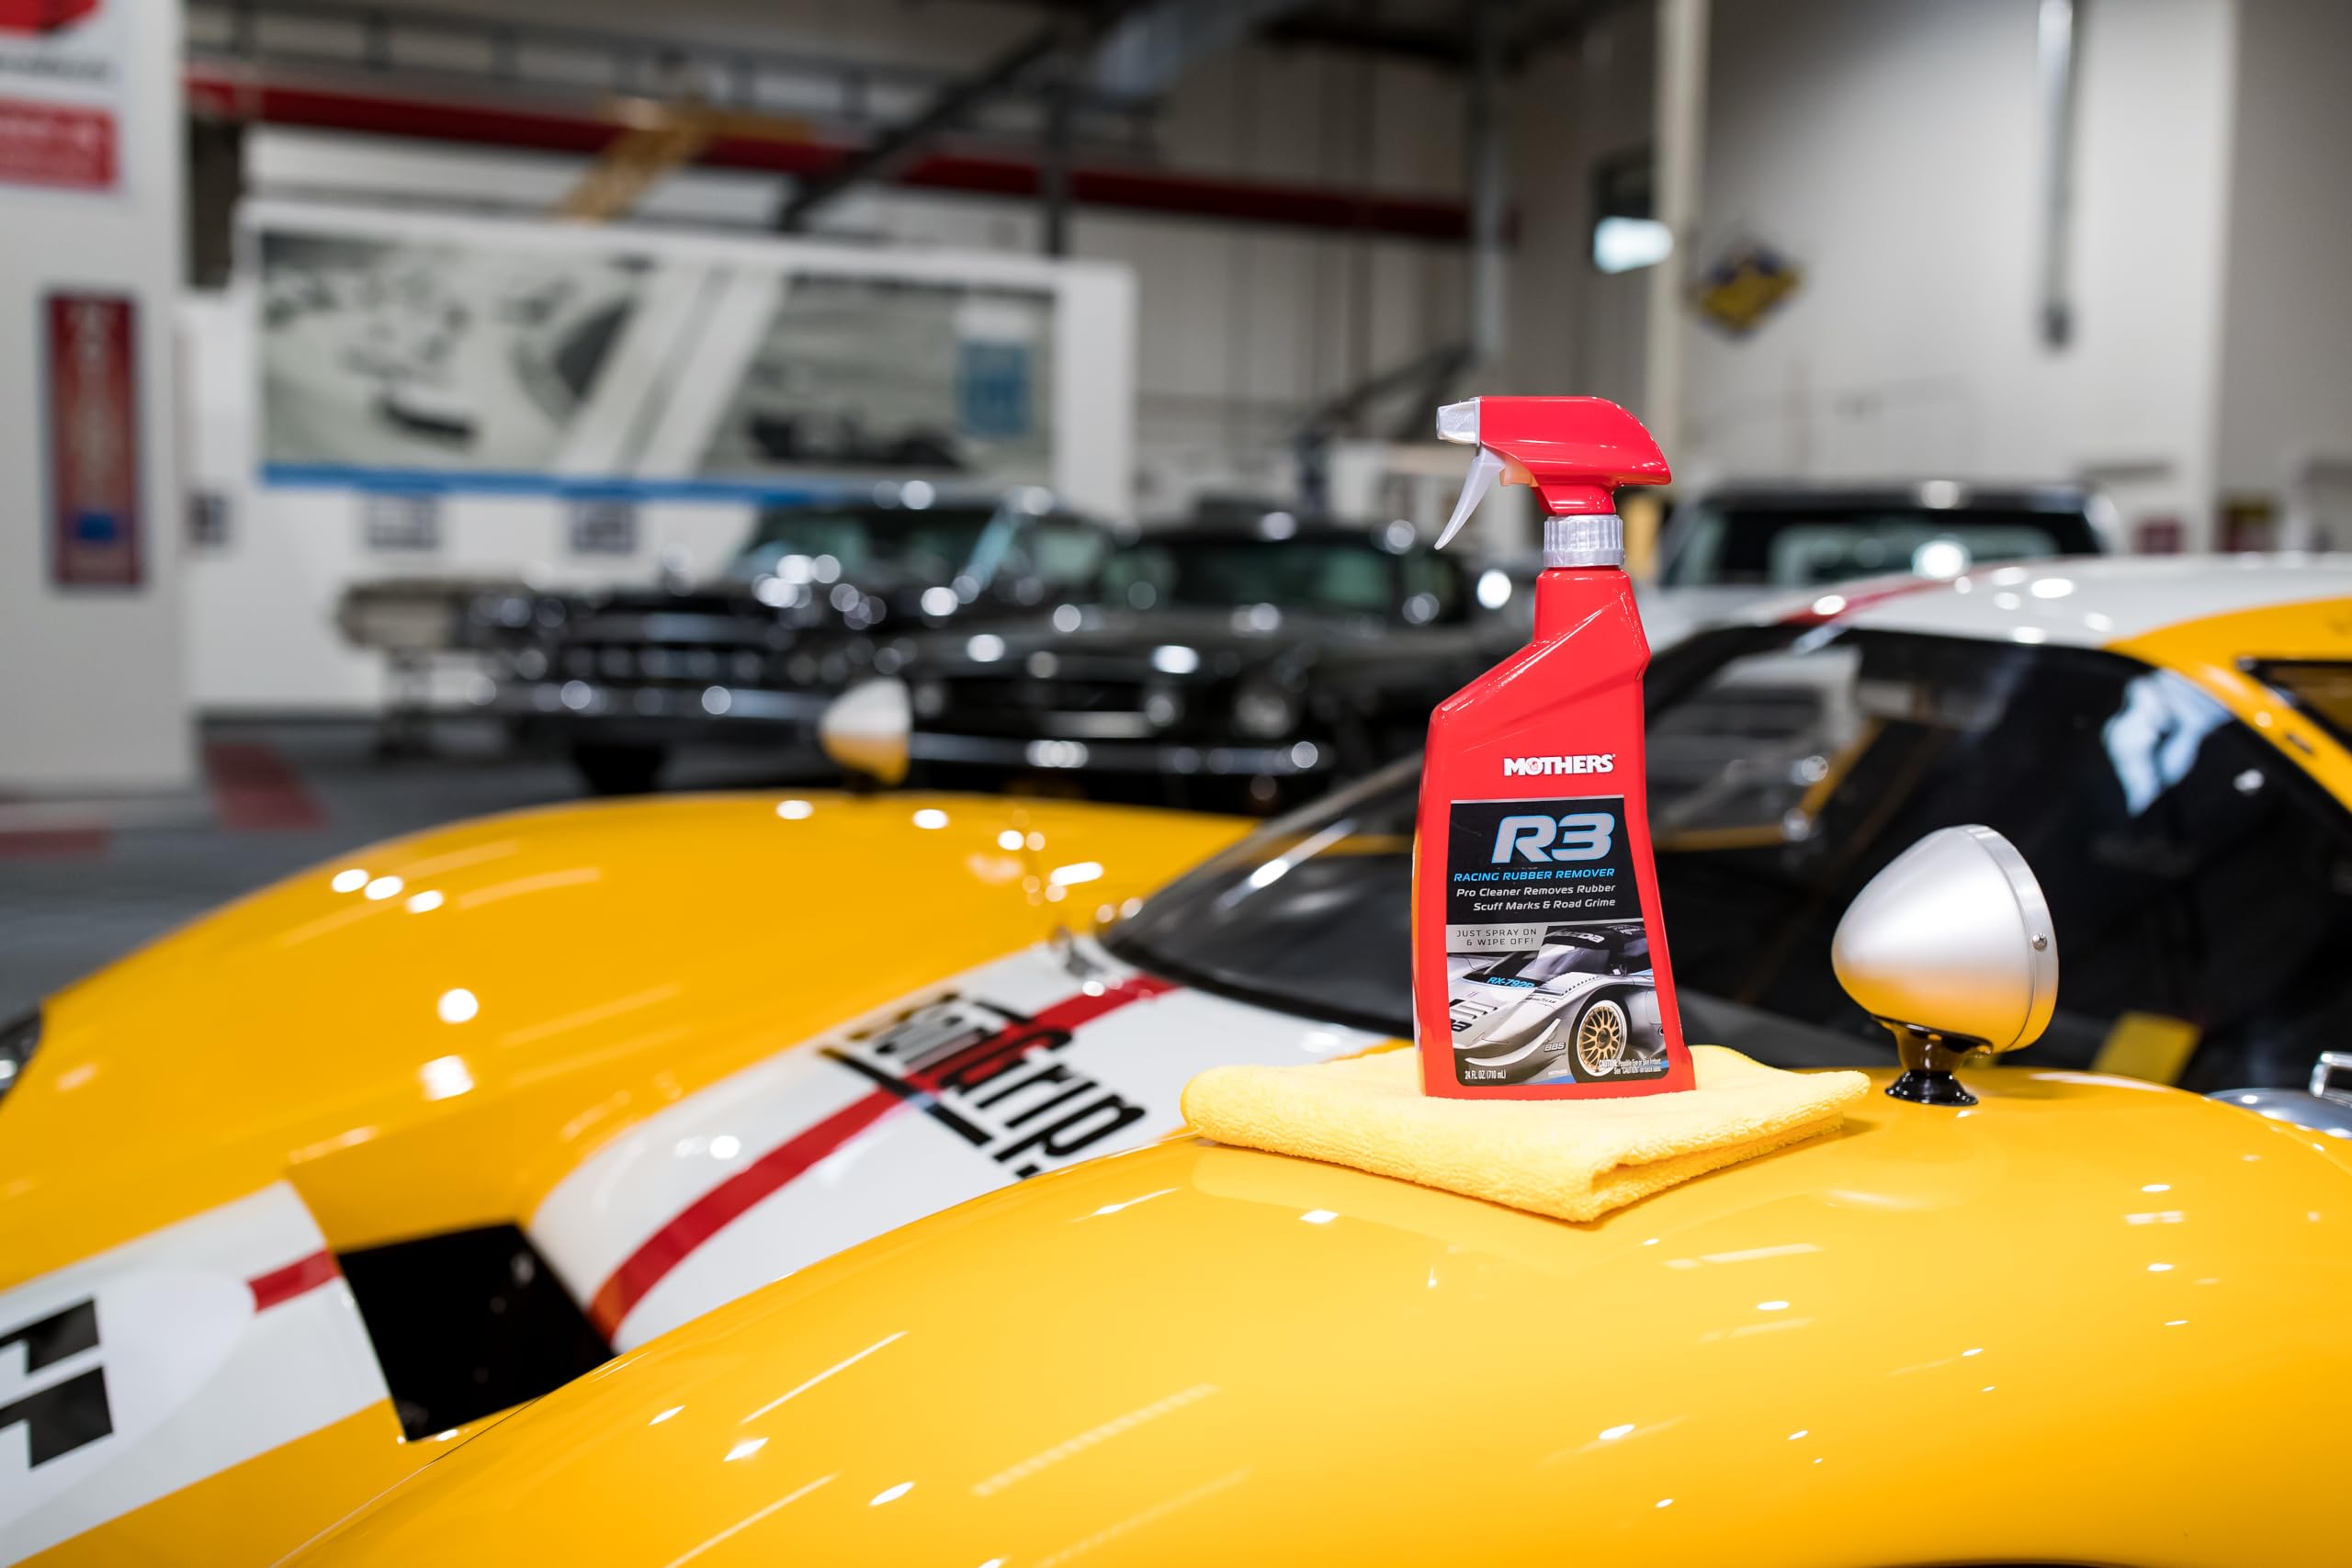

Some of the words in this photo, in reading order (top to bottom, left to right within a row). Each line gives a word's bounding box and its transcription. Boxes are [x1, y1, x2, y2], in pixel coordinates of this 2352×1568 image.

[1503, 754, 1614, 776] MOTHERS
[1490, 812, 1615, 864] R3
[1453, 872, 1500, 882] RACING
[1502, 870, 1553, 881] RUBBER
[1555, 867, 1615, 879] REMOVER
[1456, 888, 1476, 897] Pro
[1479, 887, 1521, 897] Cleaner
[1523, 886, 1574, 896] Removes
[1577, 884, 1616, 894] Rubber
[1473, 902, 1504, 911] Scuff
[1505, 901, 1541, 910] Marks
[1543, 900, 1551, 909] &
[1553, 899, 1582, 908] Road
[1584, 897, 1616, 908] Grime
[1456, 930, 1482, 938] JUST
[1486, 929, 1520, 937] SPRAY
[1522, 928, 1537, 936] ON
[1477, 938, 1506, 946] WIPE
[1510, 937, 1533, 945] OFF!
[1544, 1042, 1566, 1053] BBS
